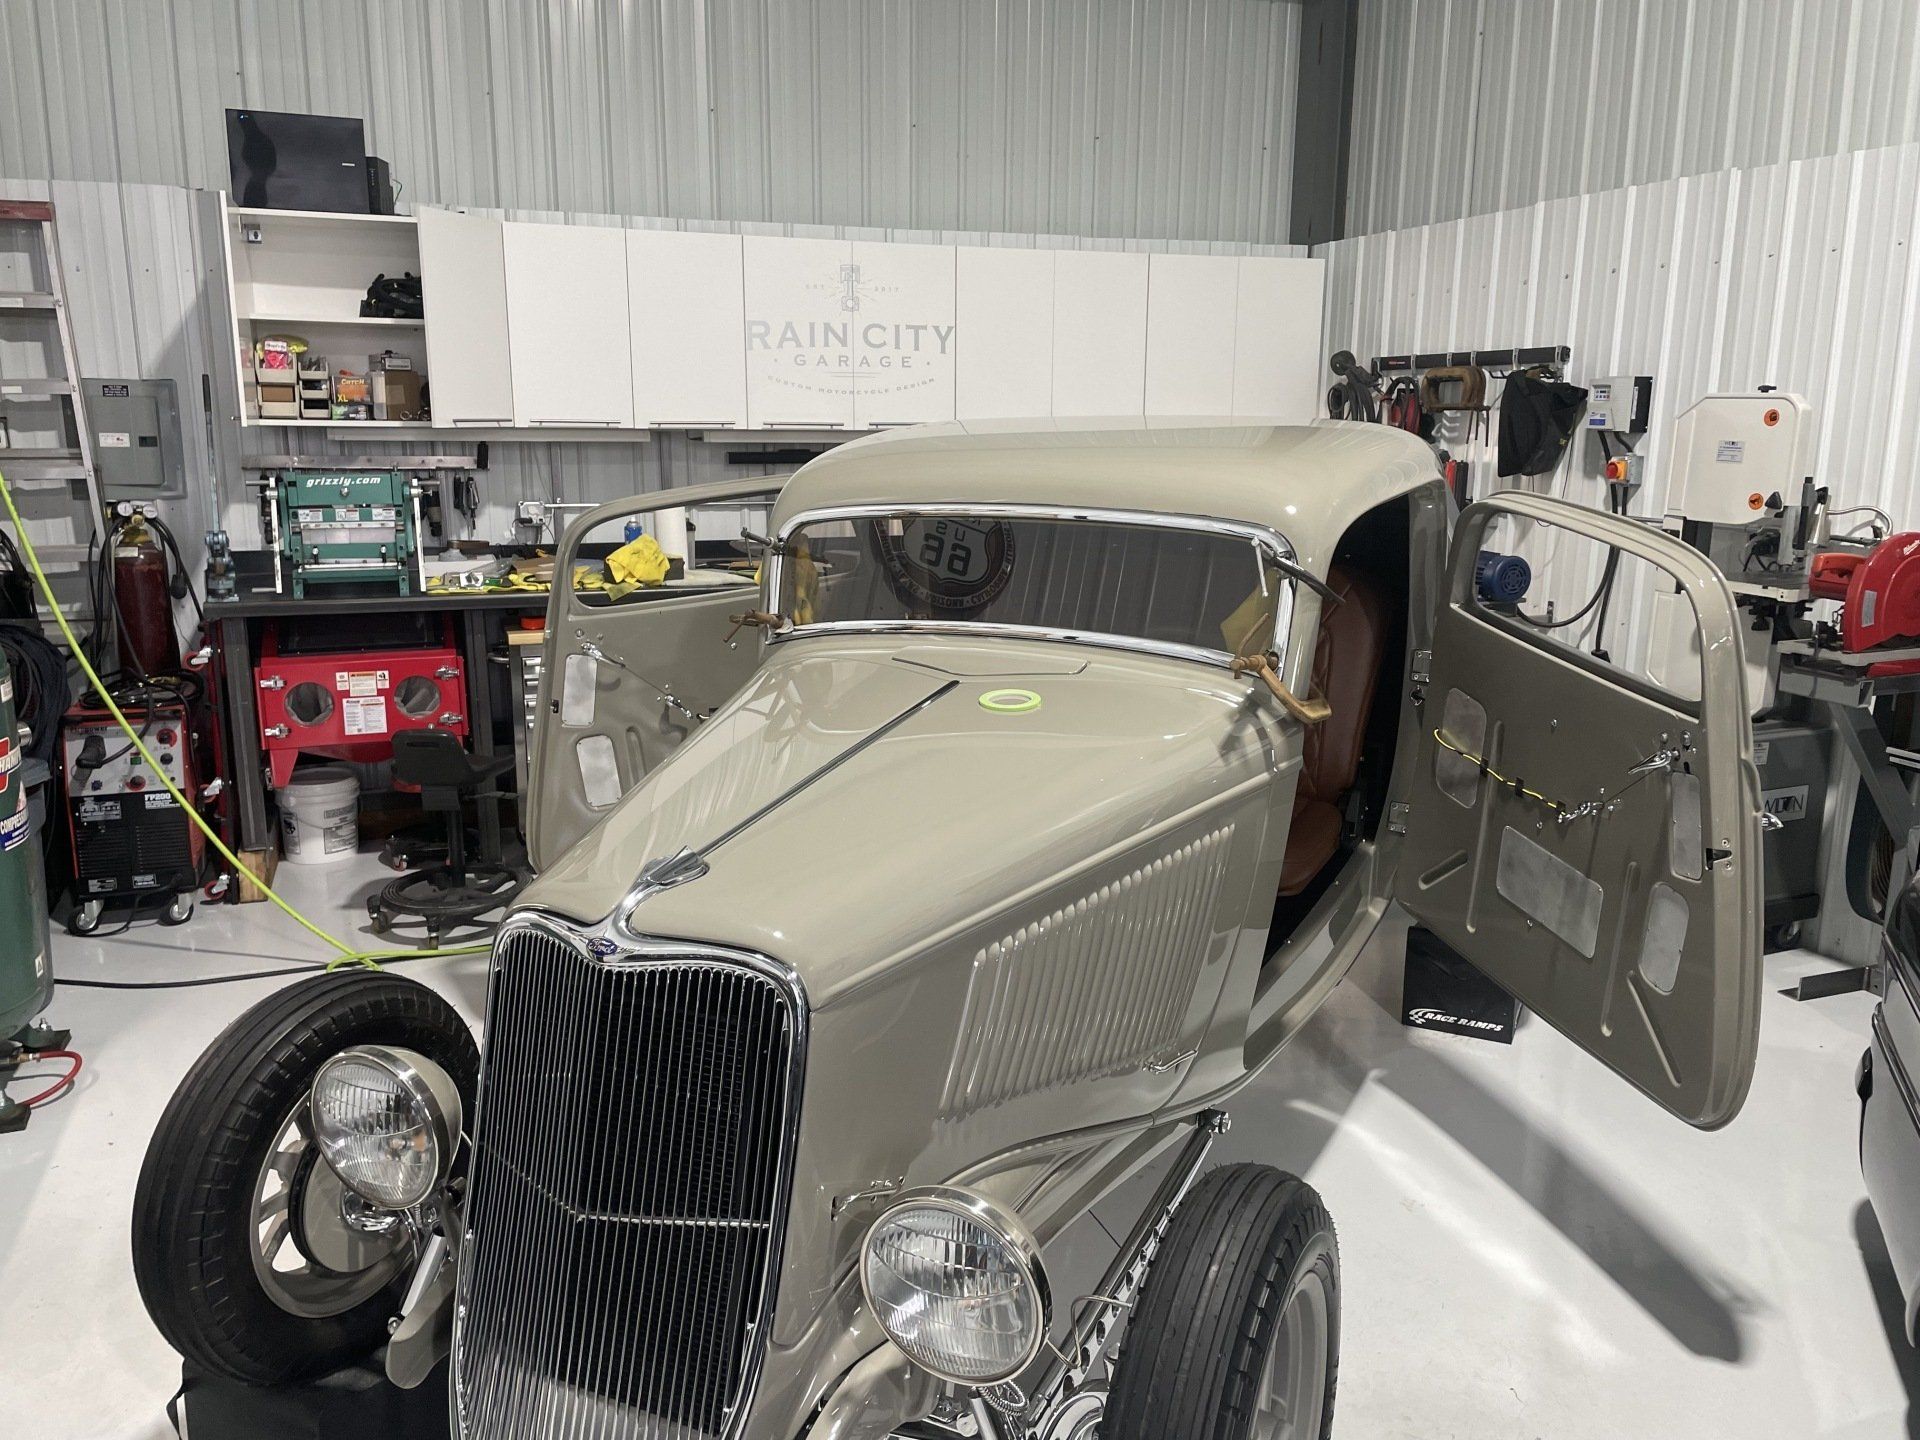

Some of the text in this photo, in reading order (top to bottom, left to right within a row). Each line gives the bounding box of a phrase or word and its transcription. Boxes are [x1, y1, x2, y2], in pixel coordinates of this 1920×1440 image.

[746, 320, 955, 354] RAIN CITY
[794, 354, 912, 368] GARAGE
[767, 375, 936, 396] CUSTOM MOTORCYCLE DESIGN
[337, 394, 349, 403] XL
[305, 476, 381, 488] grizzly.com
[144, 793, 171, 801] FP200
[1424, 1012, 1504, 1032] RACE RAMPS
